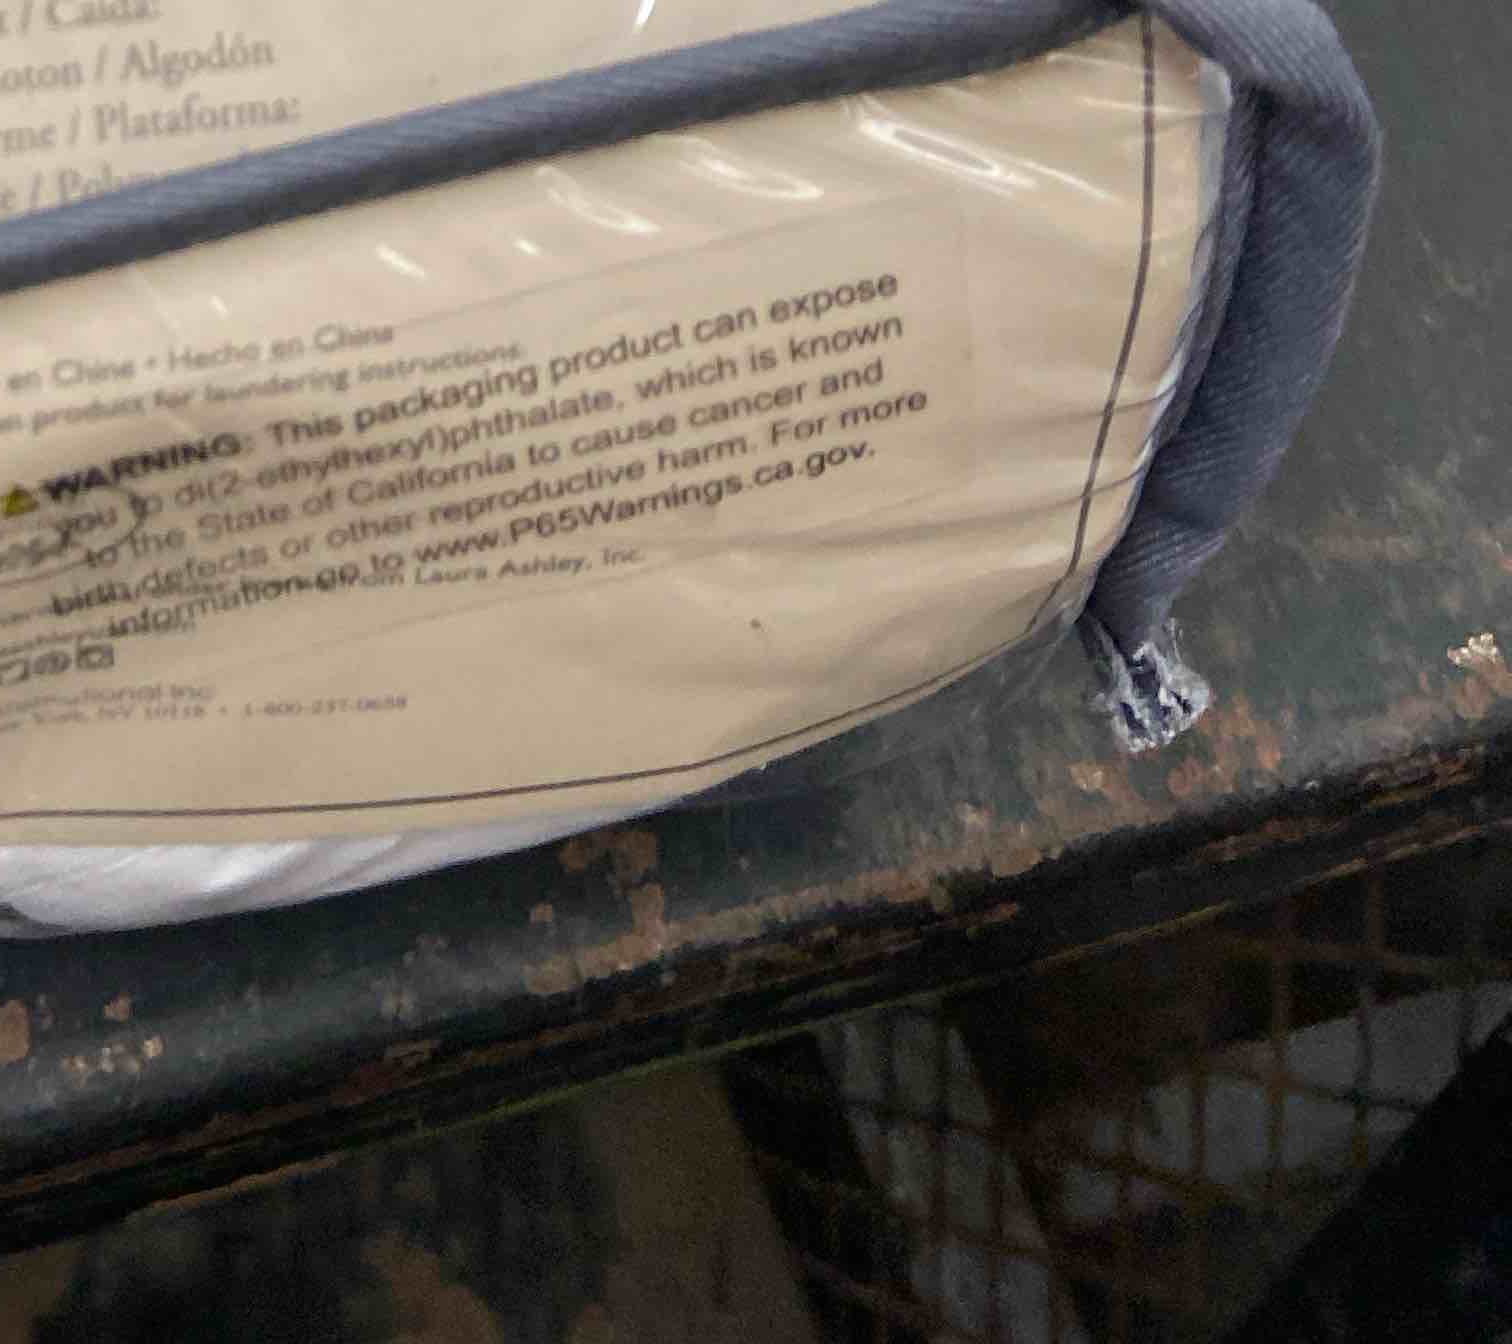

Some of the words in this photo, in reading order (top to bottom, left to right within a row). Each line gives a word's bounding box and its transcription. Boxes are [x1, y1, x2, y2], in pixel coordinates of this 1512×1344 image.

[120, 31, 276, 91] Algodón
[94, 92, 300, 144] Plataforma:
[168, 341, 261, 371] Hecho
[270, 336, 305, 360] en
[265, 413, 343, 448] This
[354, 362, 538, 433] packaging
[548, 323, 683, 385] product
[692, 306, 759, 344] can
[768, 273, 898, 323] expose
[634, 354, 738, 400] which
[749, 345, 777, 372] is
[787, 315, 903, 364] known
[129, 526, 185, 559] the
[196, 503, 290, 541] State
[301, 487, 338, 517] of
[347, 452, 516, 506] California
[528, 441, 561, 466] to
[570, 413, 677, 456] cause
[688, 381, 808, 428] cancer
[820, 357, 884, 397] and
[140, 545, 269, 597] defects
[279, 533, 314, 560] or
[325, 515, 414, 549] other
[429, 459, 646, 524] reproductive
[655, 433, 759, 473] harm.
[769, 417, 828, 447] For
[838, 391, 928, 430] more
[315, 562, 361, 592] go
[370, 552, 405, 576] to
